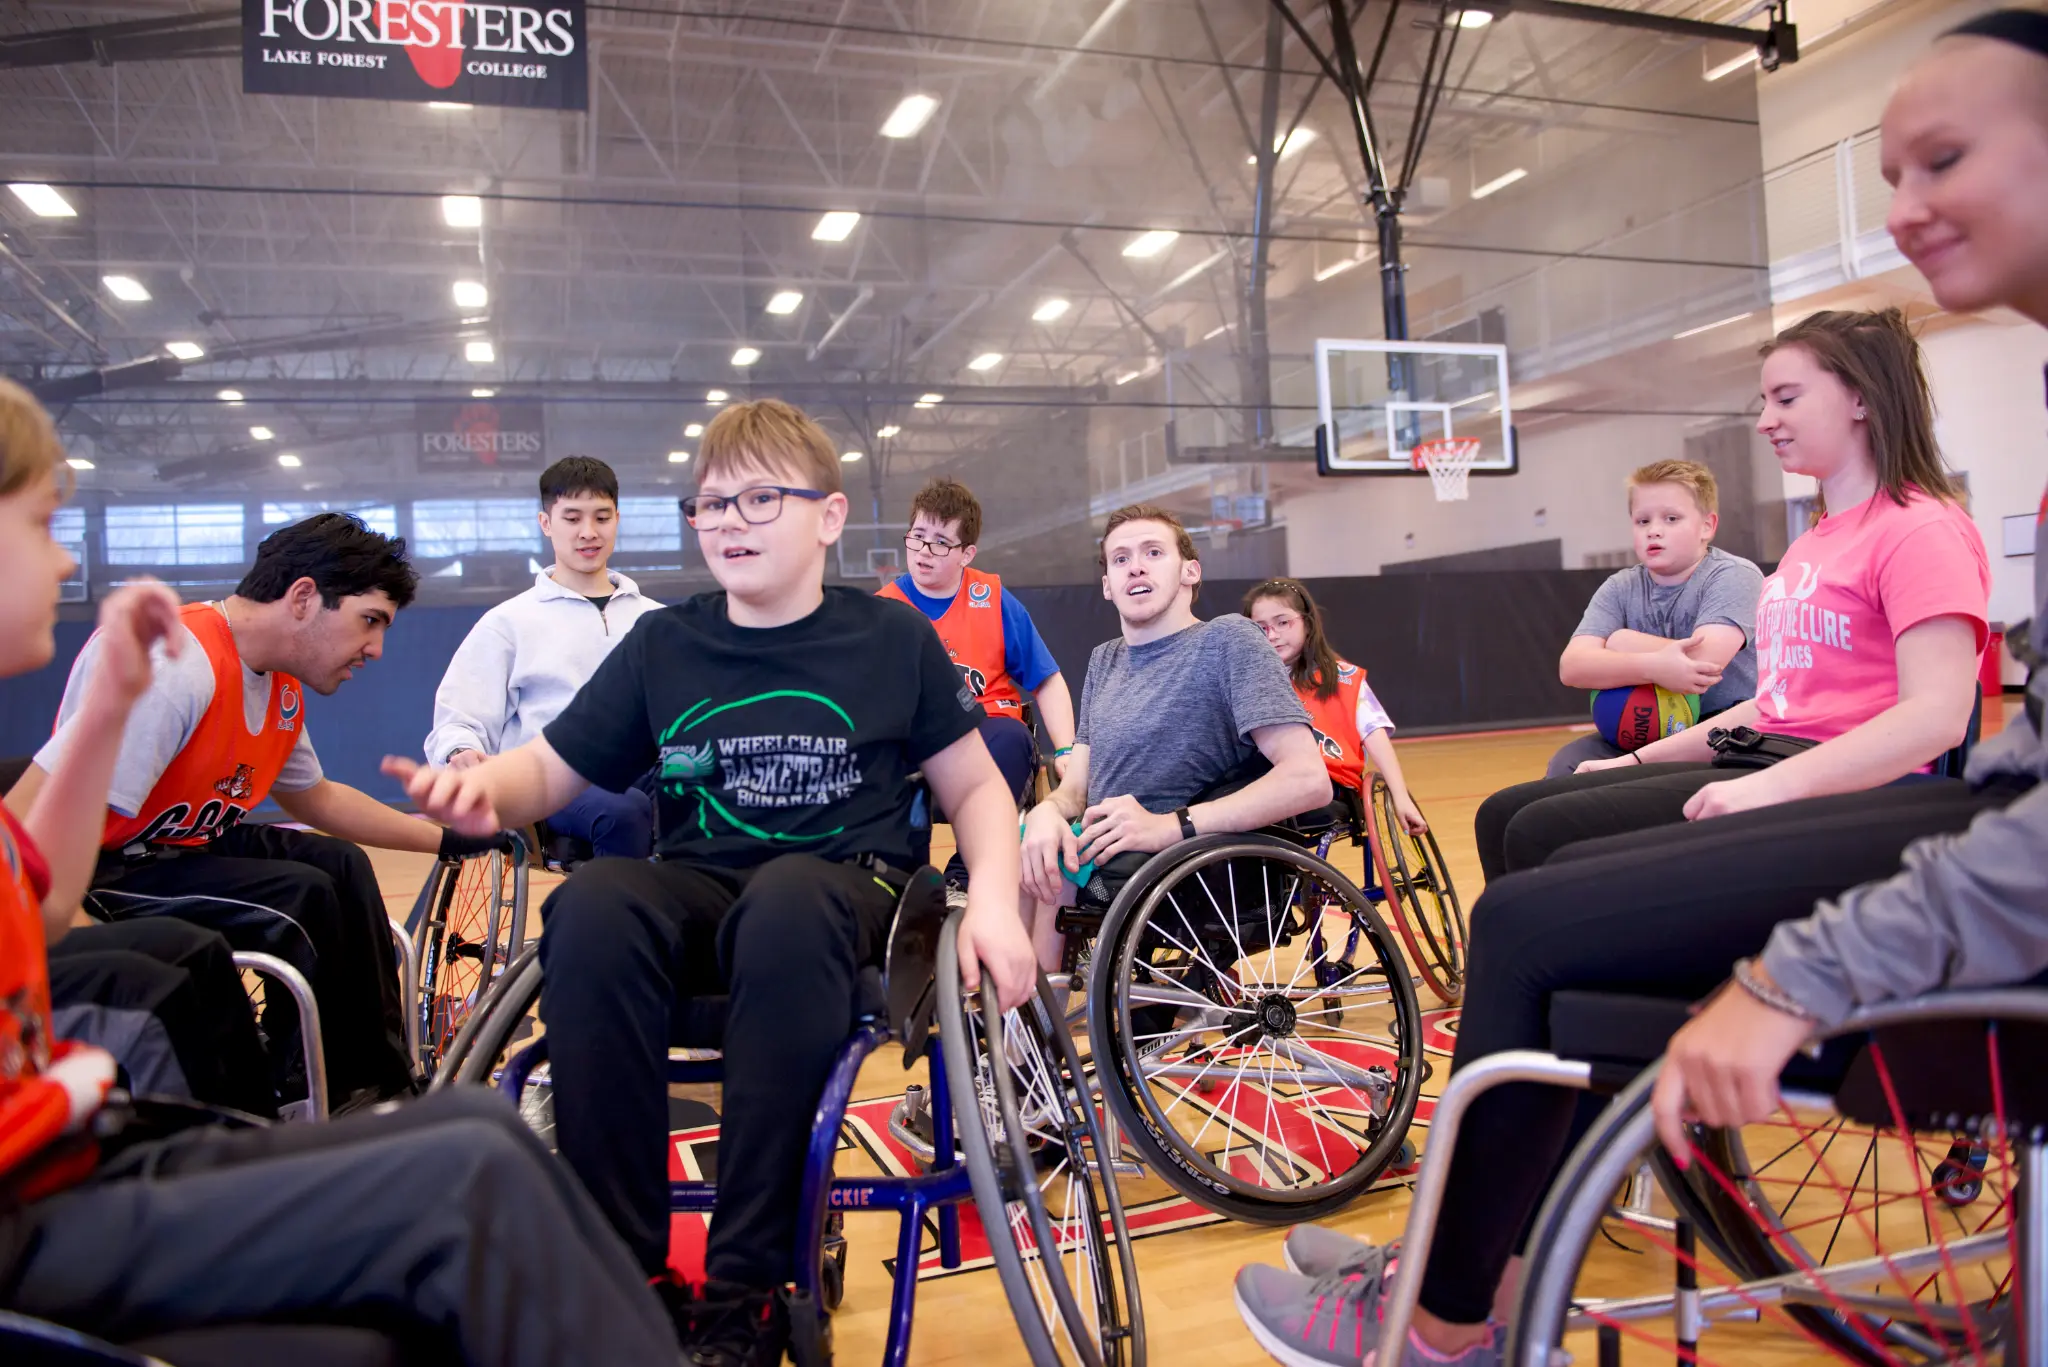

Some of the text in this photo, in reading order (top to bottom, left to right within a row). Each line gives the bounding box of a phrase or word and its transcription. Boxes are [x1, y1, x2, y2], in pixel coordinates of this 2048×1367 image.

[259, 0, 575, 56] FORESTERS
[262, 49, 548, 79] LAKE FOREST COLLEGE
[422, 431, 541, 453] FORESTERS
[1800, 602, 1853, 652] CURE
[717, 734, 848, 756] WHEELCHAIR
[719, 752, 863, 794] BASKETBALL
[1138, 1111, 1231, 1195] SPINERGY
[829, 1187, 870, 1206] CKIE
